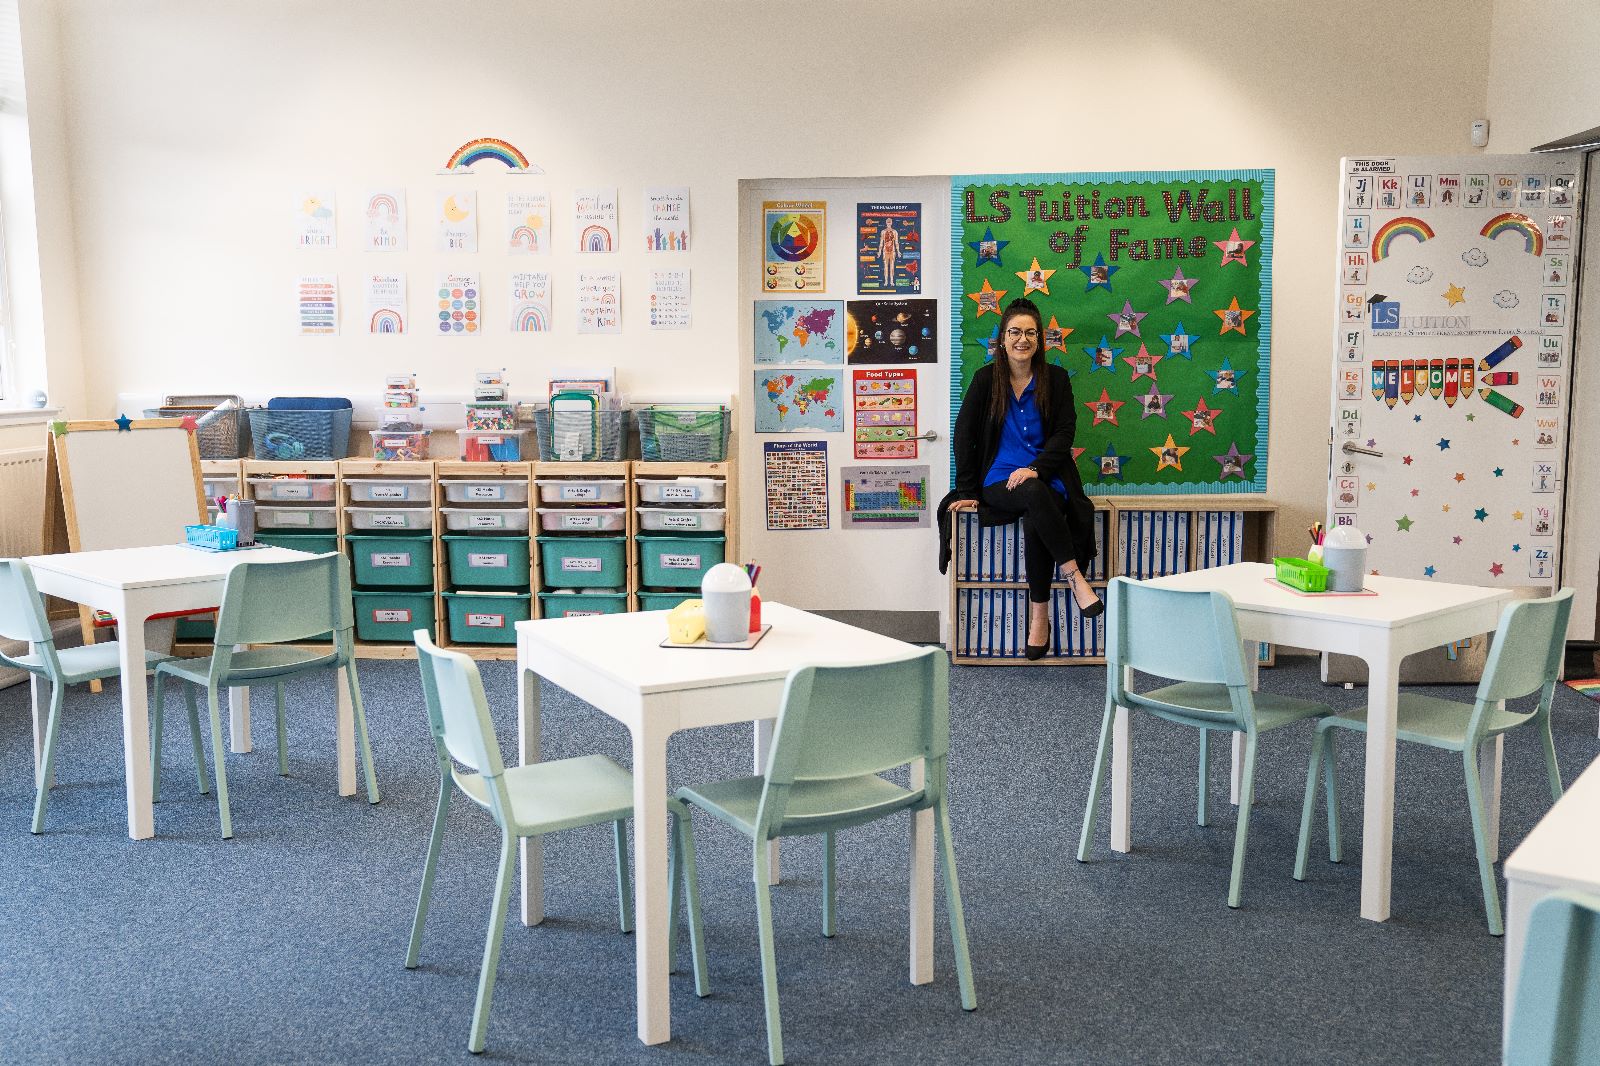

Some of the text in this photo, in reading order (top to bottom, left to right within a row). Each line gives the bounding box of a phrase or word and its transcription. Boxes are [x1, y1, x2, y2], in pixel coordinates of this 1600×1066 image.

[1356, 179, 1367, 191] Jj
[1382, 179, 1398, 190] Kk
[1414, 178, 1425, 189] Ll
[1439, 177, 1458, 187] Mm
[1469, 177, 1484, 187] Nn
[1498, 177, 1513, 187] Oo
[1527, 177, 1541, 189] Pp
[966, 188, 1256, 224] LS Tuition Wall
[1353, 218, 1363, 229] Ii
[373, 236, 397, 247] KIND
[1048, 224, 1207, 269] of Fame
[1348, 255, 1365, 266] Hh
[1550, 257, 1562, 267] Ss
[1347, 294, 1363, 306] Gg
[1547, 297, 1560, 307] Tt
[1373, 307, 1399, 324] LS
[1400, 315, 1470, 329] TUITION
[1347, 332, 1360, 346] Ff
[1543, 338, 1558, 348] Uu
[884, 371, 904, 379] Types
[1345, 371, 1359, 381] Ee
[1373, 370, 1471, 386] WELCOME
[1541, 378, 1557, 388] Vv
[1342, 410, 1358, 420] Dd
[1536, 419, 1557, 428] Ww
[1538, 465, 1552, 473] Xx
[1340, 480, 1355, 489] Cc
[1537, 507, 1549, 519] Yy
[1338, 516, 1353, 526] Bb
[1535, 549, 1549, 559] Zz
